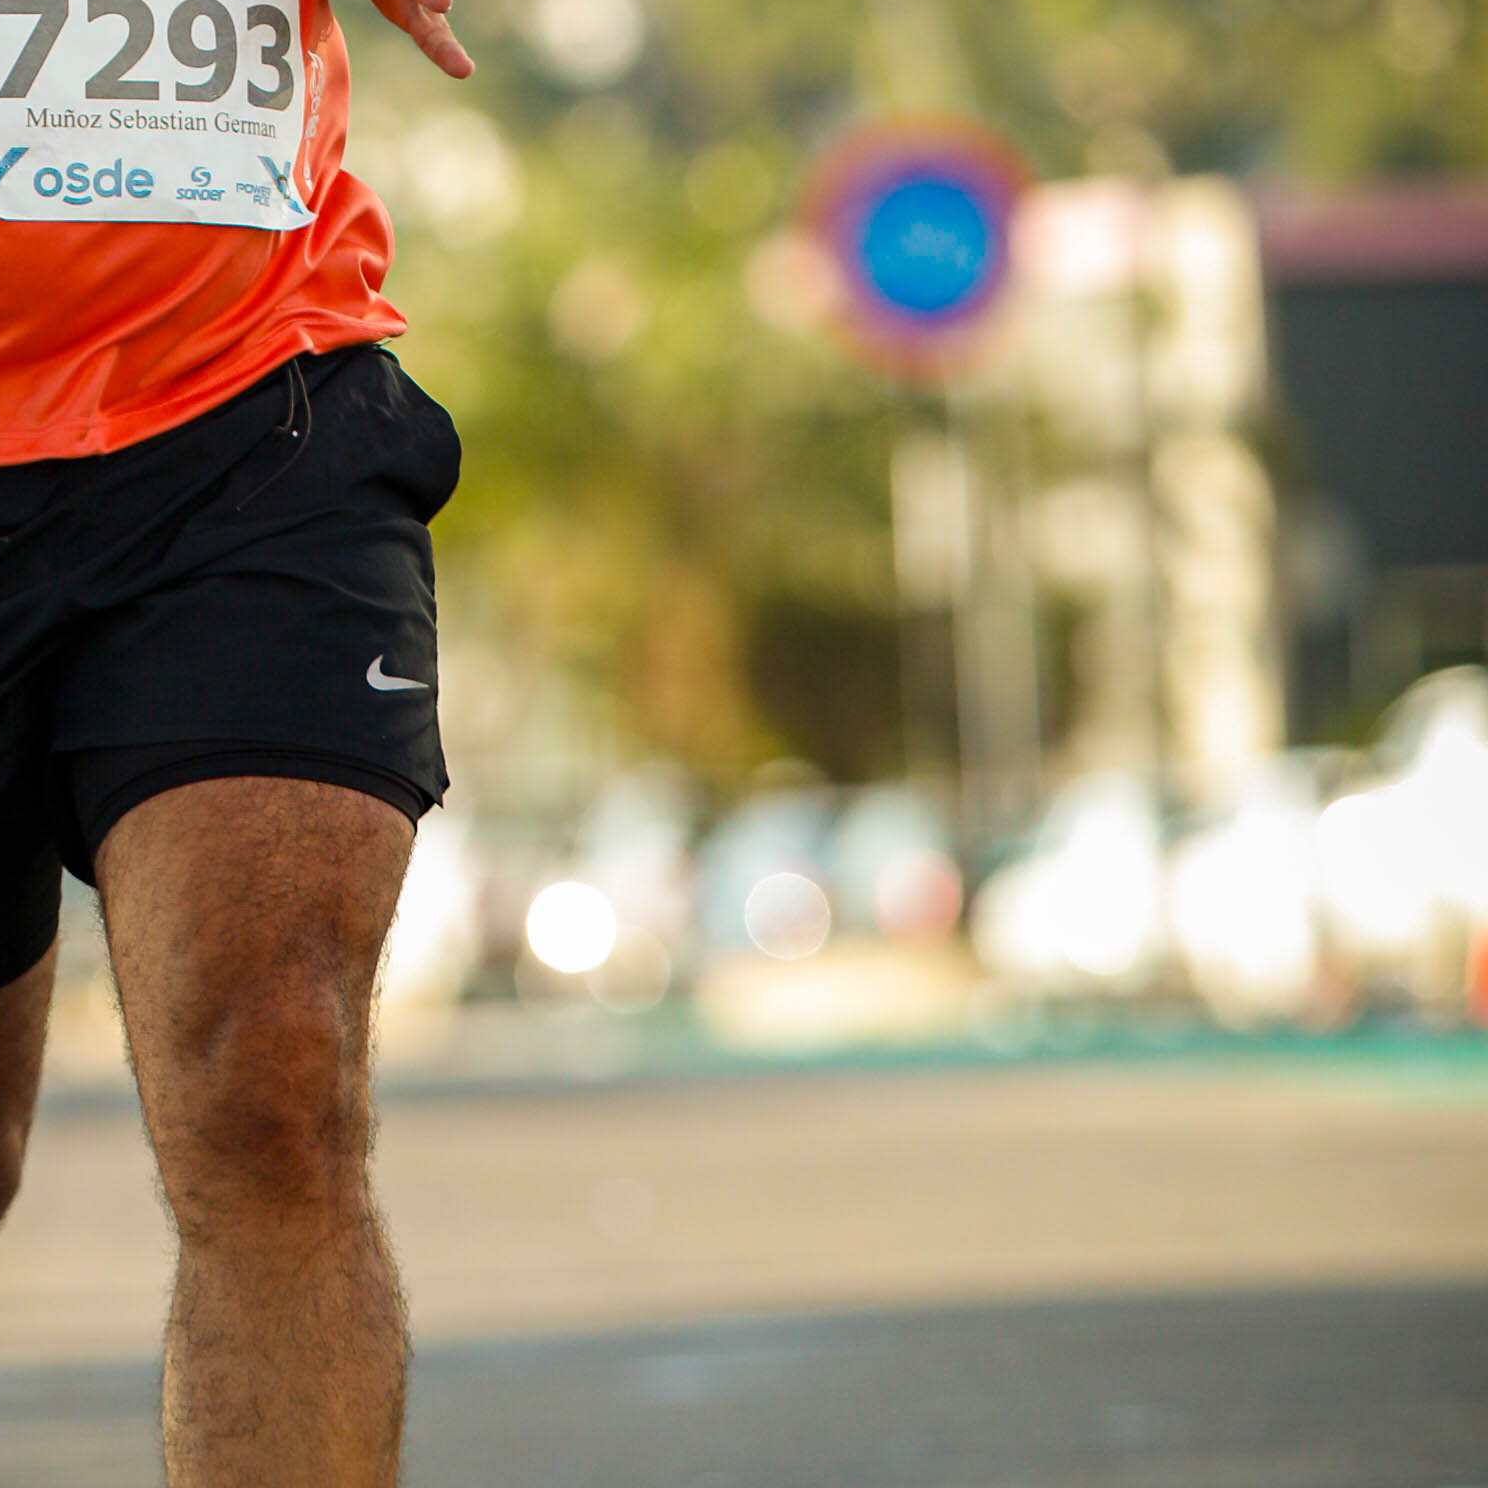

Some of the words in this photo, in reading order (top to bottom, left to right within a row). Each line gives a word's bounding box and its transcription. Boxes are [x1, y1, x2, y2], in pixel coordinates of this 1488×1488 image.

[25, 107, 103, 129] Muñoz
[109, 108, 208, 131] Sebastian
[214, 111, 277, 139] German
[33, 158, 155, 200] osde
